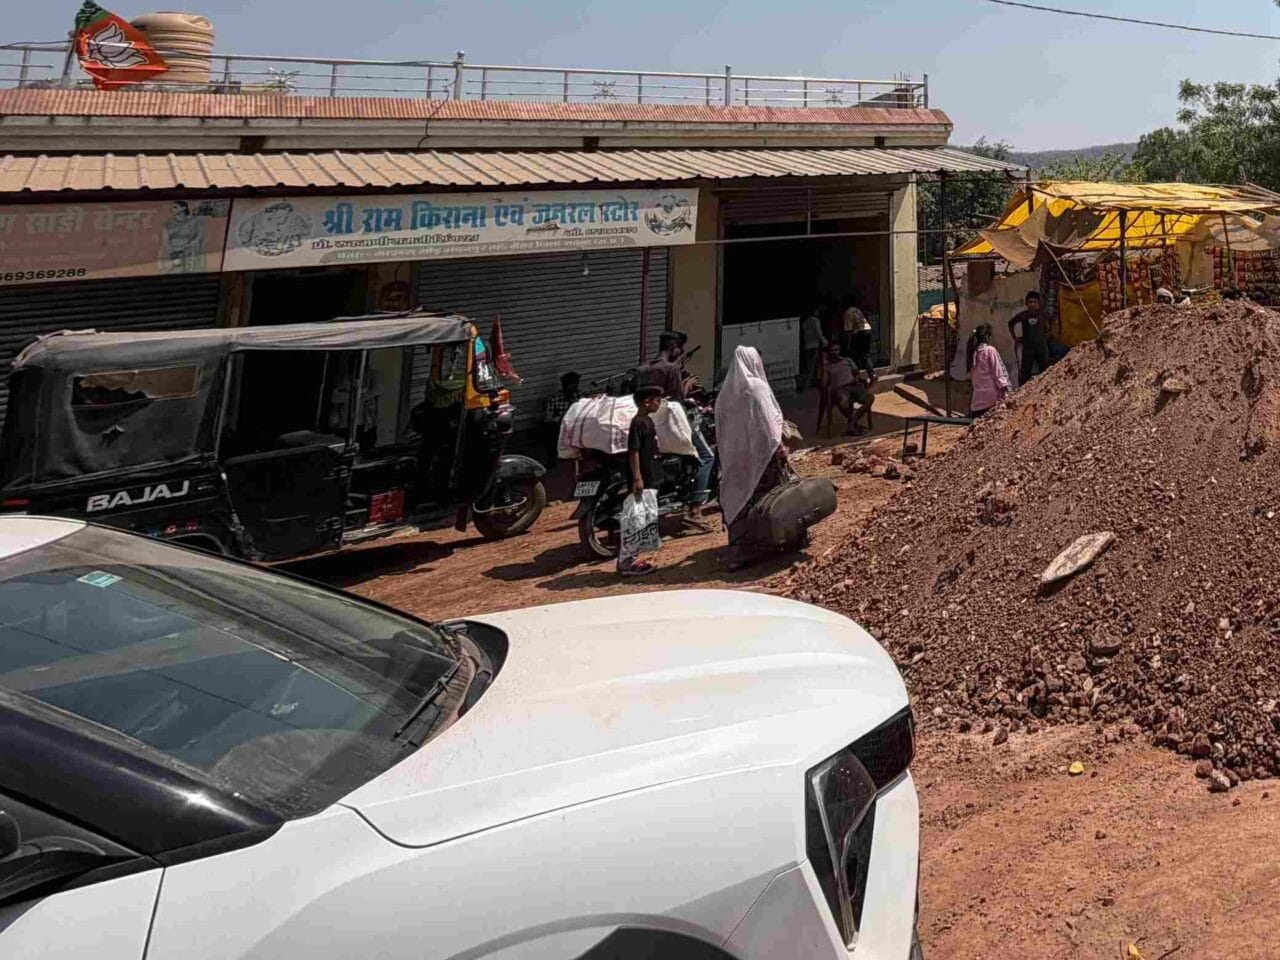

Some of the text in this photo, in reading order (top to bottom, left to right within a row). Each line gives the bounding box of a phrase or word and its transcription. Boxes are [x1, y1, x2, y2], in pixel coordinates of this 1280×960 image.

[322, 195, 640, 234] श्री राम किराना एवं जनरल स्टोर
[86, 480, 190, 512] BAJAJ
